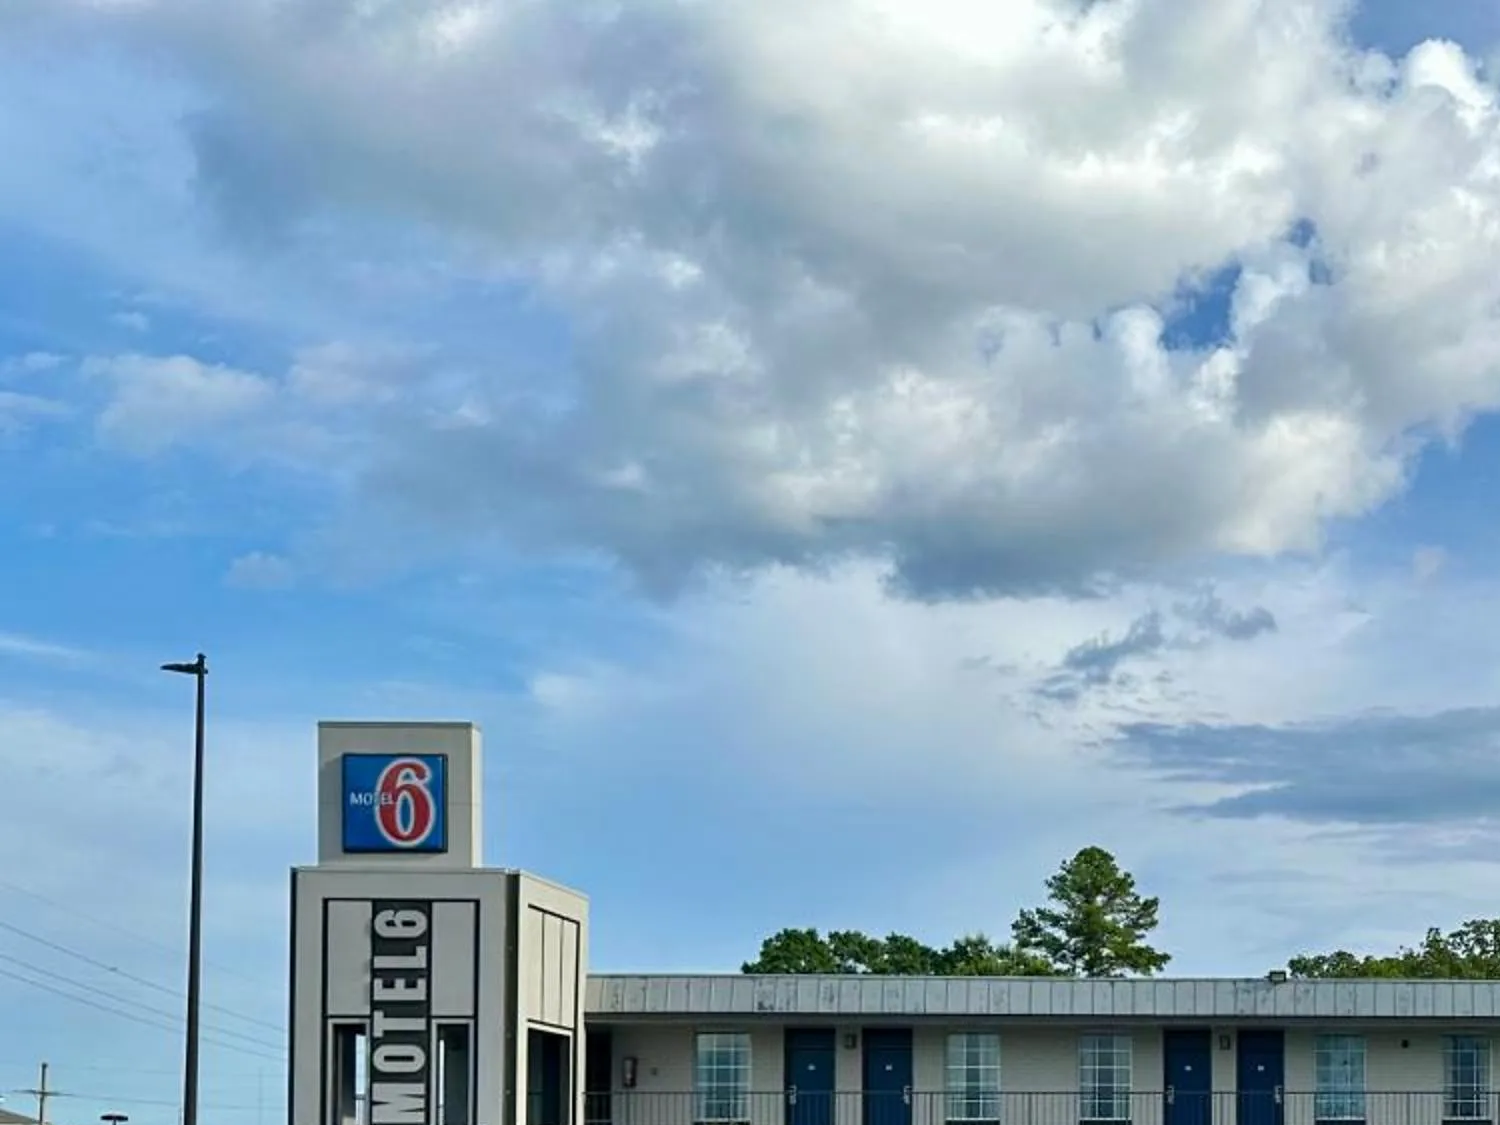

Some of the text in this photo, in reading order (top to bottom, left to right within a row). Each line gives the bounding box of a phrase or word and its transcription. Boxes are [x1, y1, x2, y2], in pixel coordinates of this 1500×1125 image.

[375, 757, 435, 847] 6
[372, 909, 428, 1124] MOTEL 6
